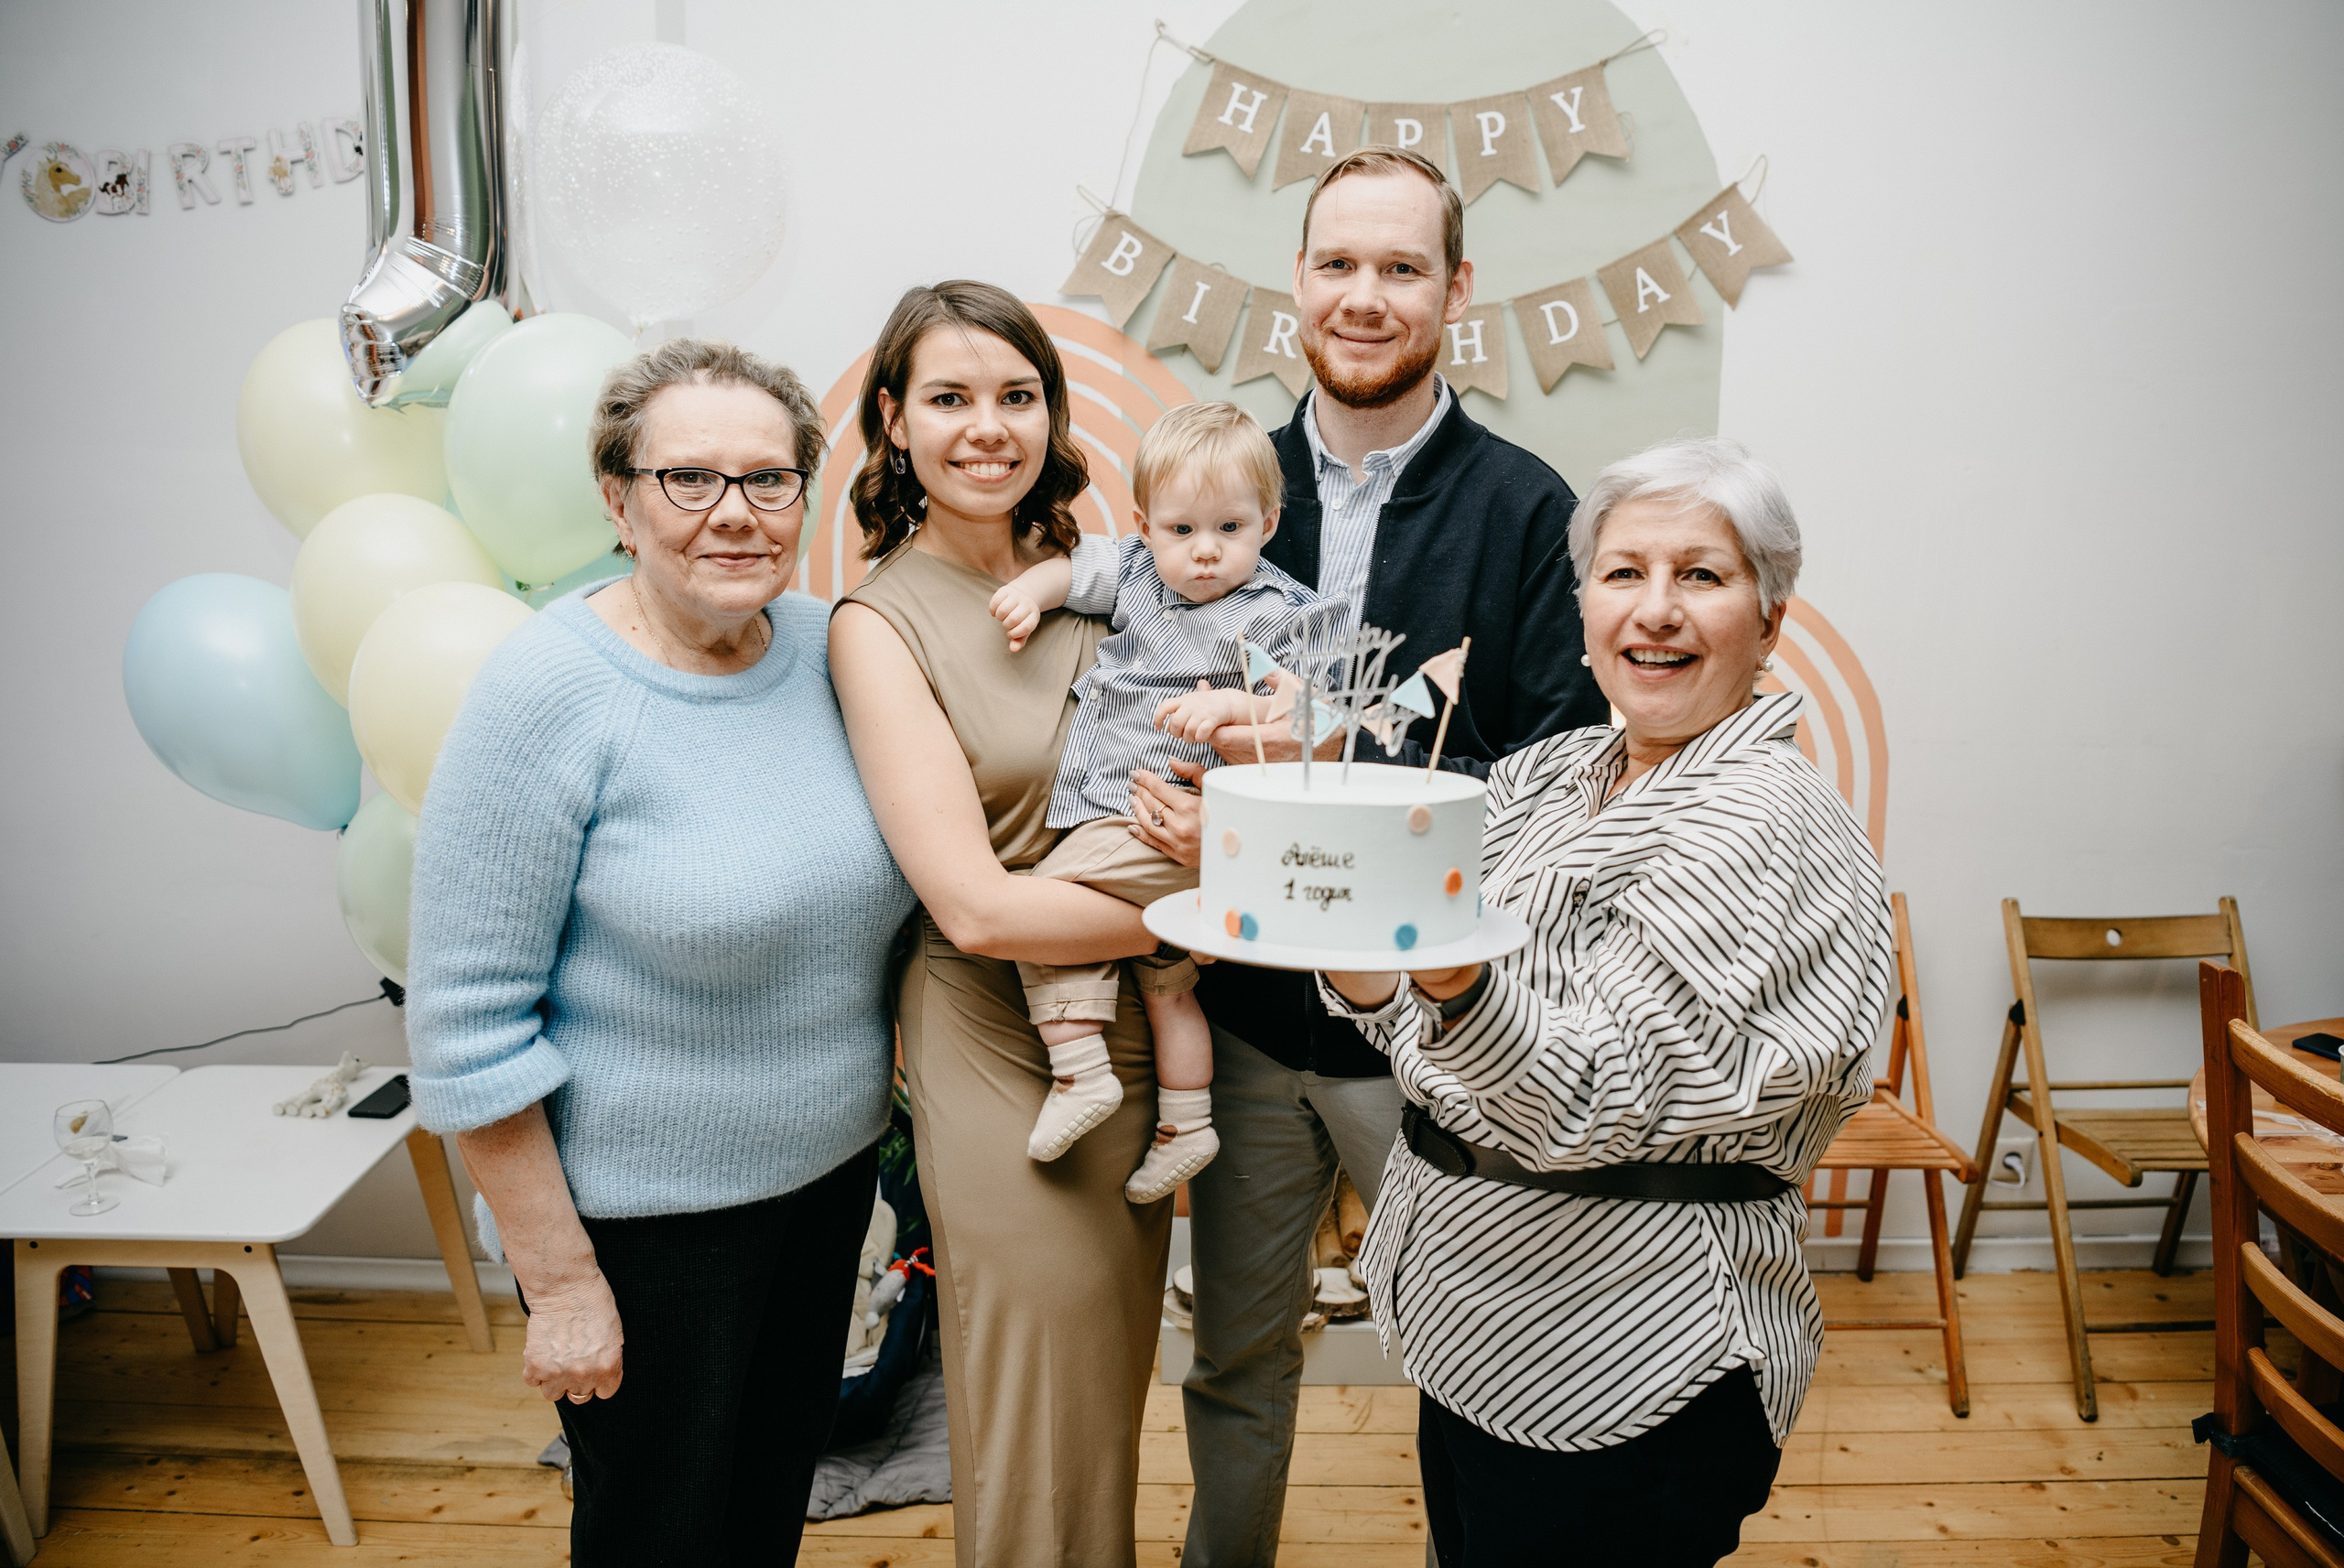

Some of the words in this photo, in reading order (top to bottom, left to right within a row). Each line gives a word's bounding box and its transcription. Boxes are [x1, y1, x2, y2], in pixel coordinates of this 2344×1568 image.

[1217, 81, 1587, 157] HAPPY
[95, 116, 364, 216] BIRTHD
[1100, 210, 1743, 366] BIRHDAY
[1284, 878, 1295, 900] 1
